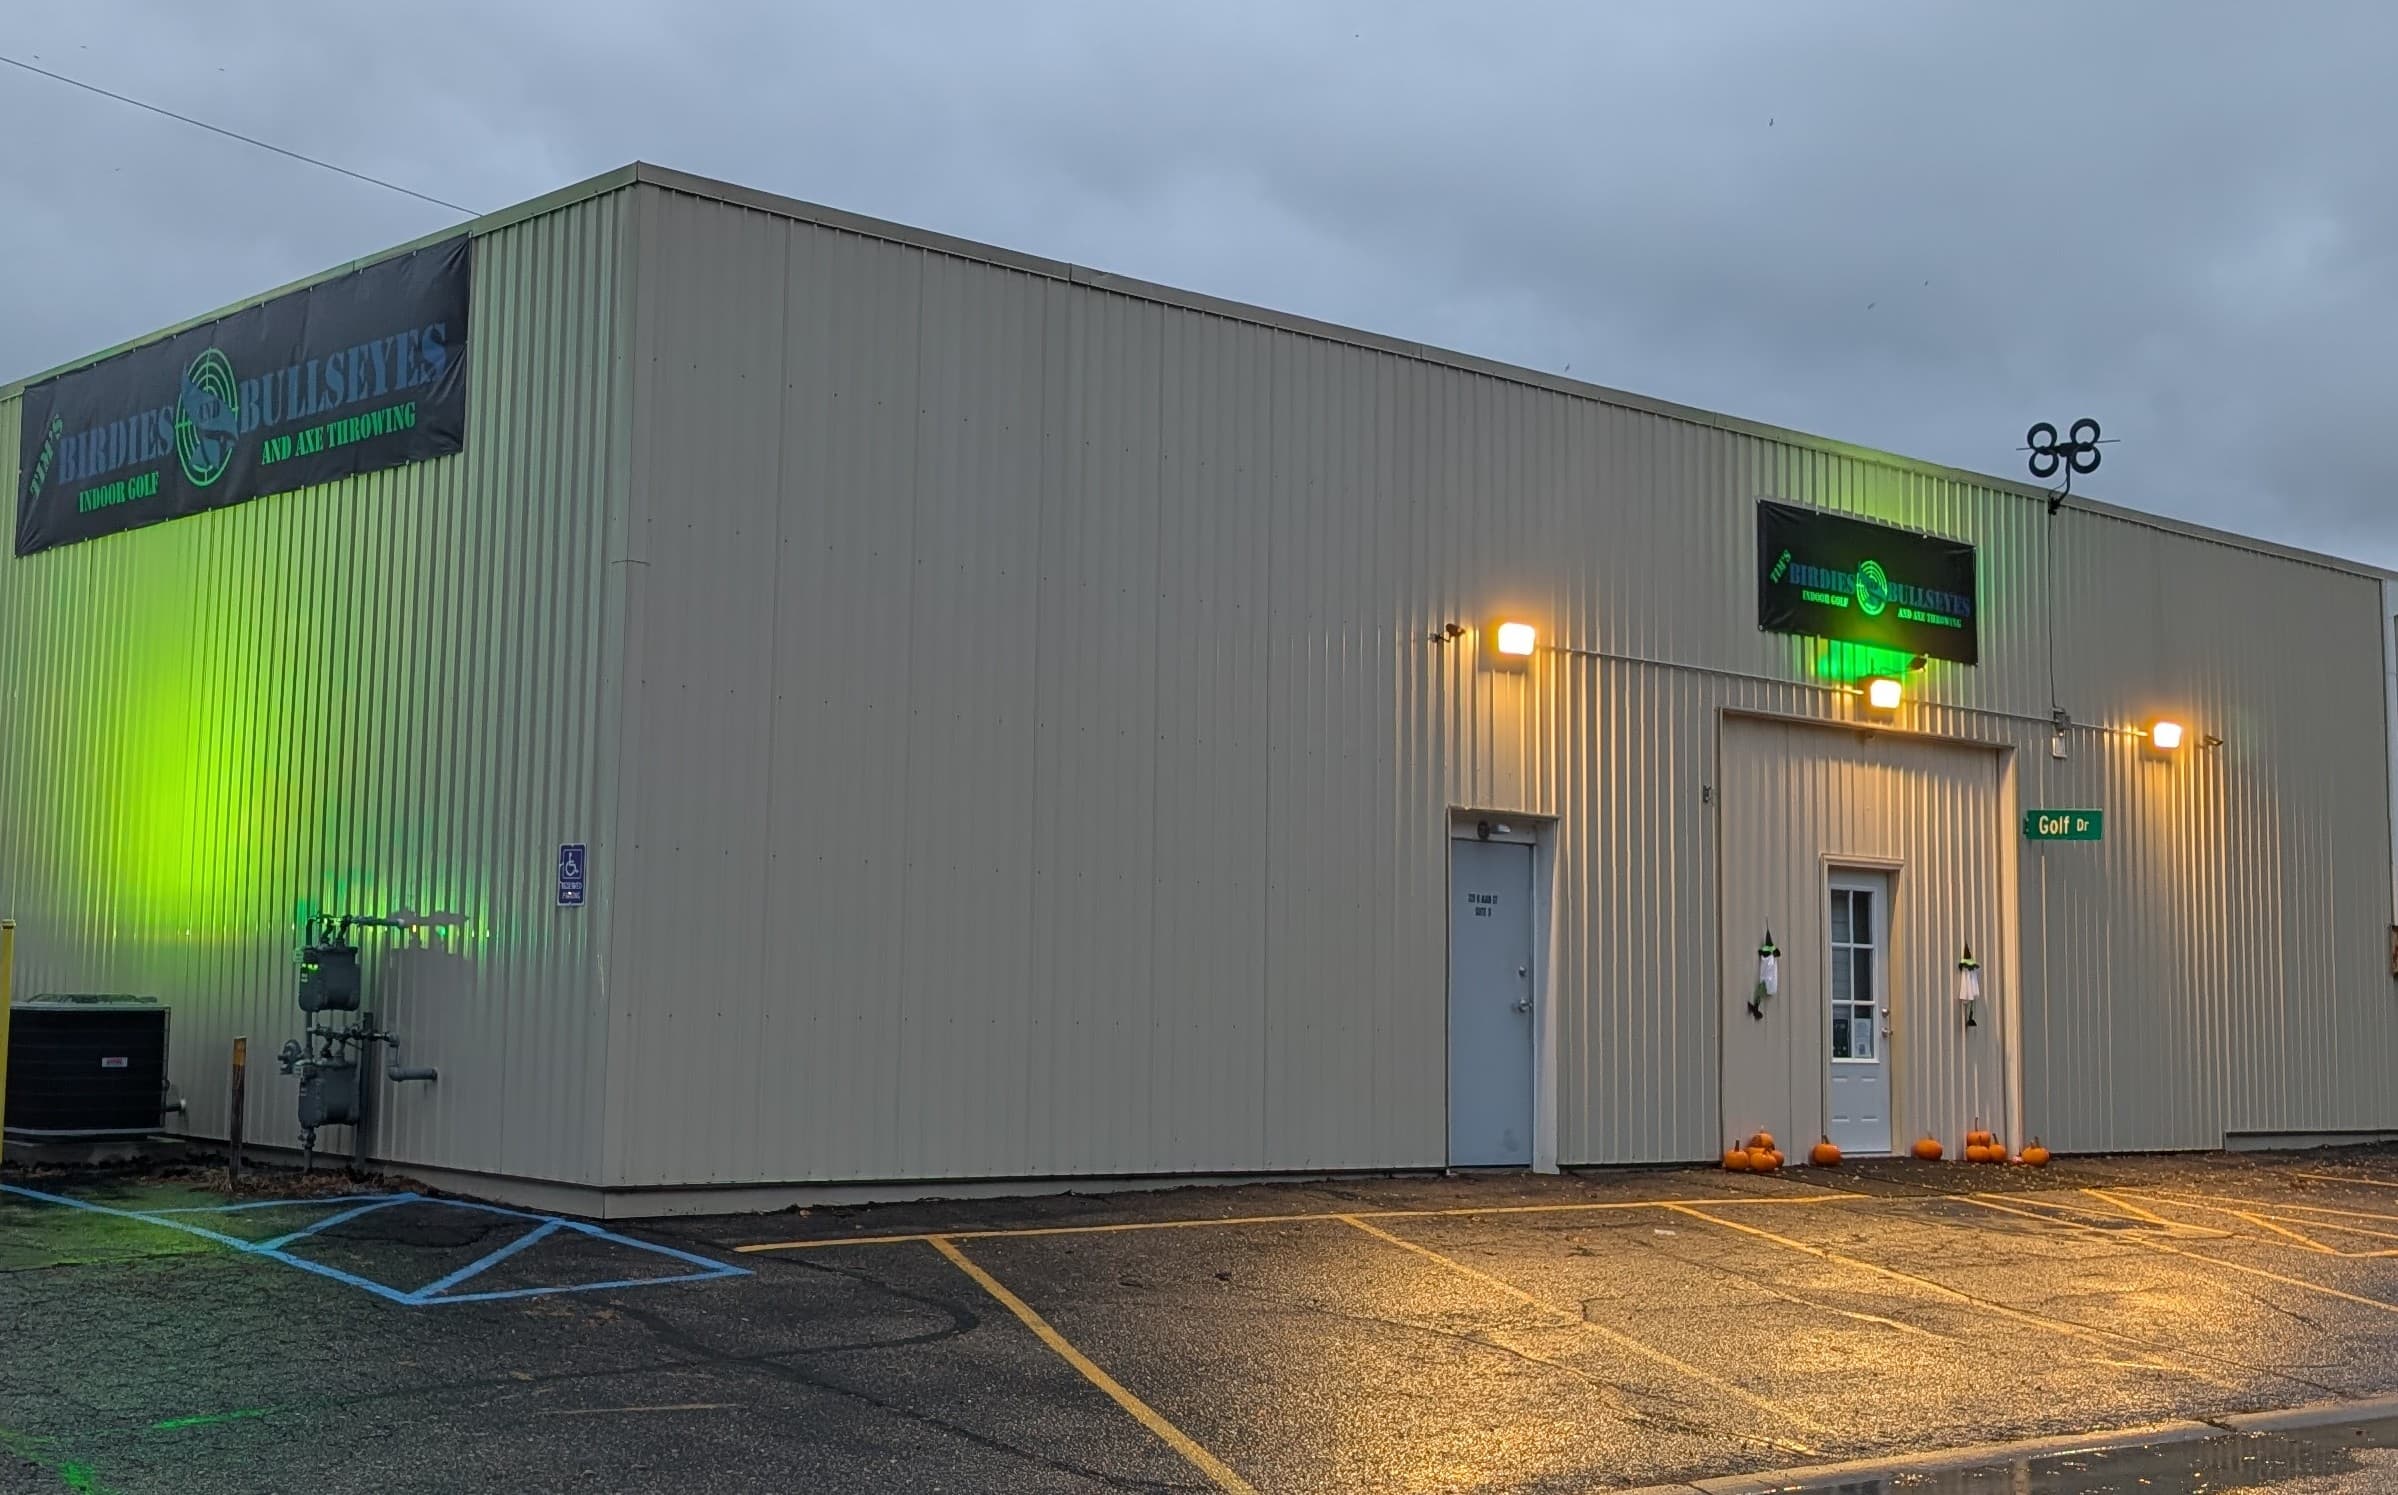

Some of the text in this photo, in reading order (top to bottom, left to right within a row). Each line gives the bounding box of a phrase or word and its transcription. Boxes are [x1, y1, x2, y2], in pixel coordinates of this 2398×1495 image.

[58, 405, 175, 485] BIRDIES
[239, 323, 448, 434] BULLSEYES
[261, 401, 417, 465] AND AXE THROWING
[29, 413, 65, 498] TIM'S
[78, 471, 160, 513] INDOOR GOLF
[1770, 549, 1792, 584] TIM'S
[1789, 562, 1855, 594] BIRDIES
[1889, 582, 1971, 617] BULLSEYES
[1802, 590, 1849, 608] INDOOR GOLF
[1926, 613, 1962, 629] THROWING
[2039, 815, 2090, 835] Golf Dr
